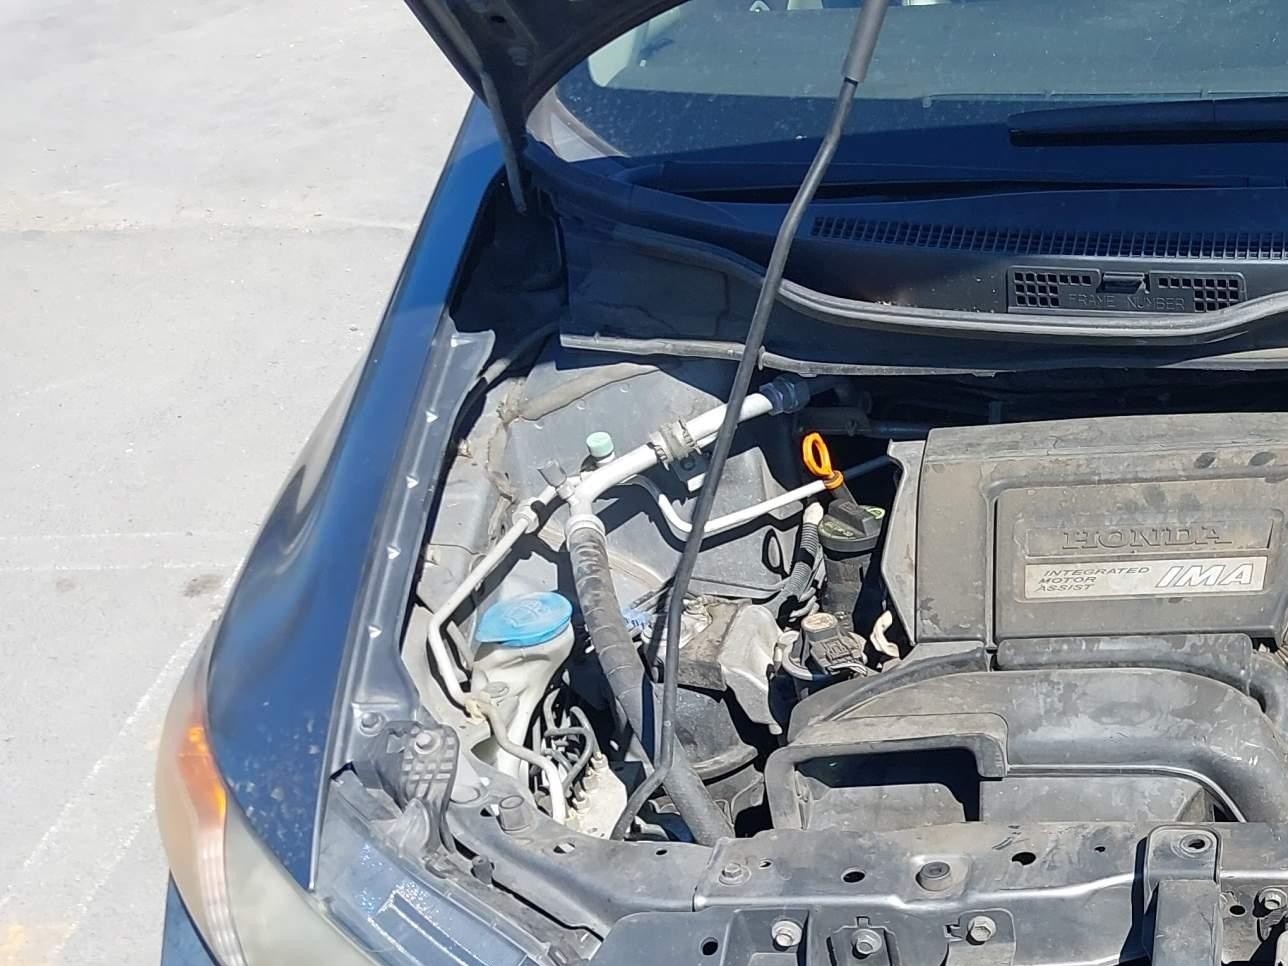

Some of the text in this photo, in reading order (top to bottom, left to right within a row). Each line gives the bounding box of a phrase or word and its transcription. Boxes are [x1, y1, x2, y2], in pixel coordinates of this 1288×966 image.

[1068, 293, 1185, 311] FRAME NUMBER
[1061, 526, 1233, 550] HONDA
[1043, 567, 1150, 577] INTEGRATED
[1155, 563, 1254, 588] IMA
[1034, 583, 1095, 592] ASSIST
[1038, 576, 1097, 585] MOTOR
